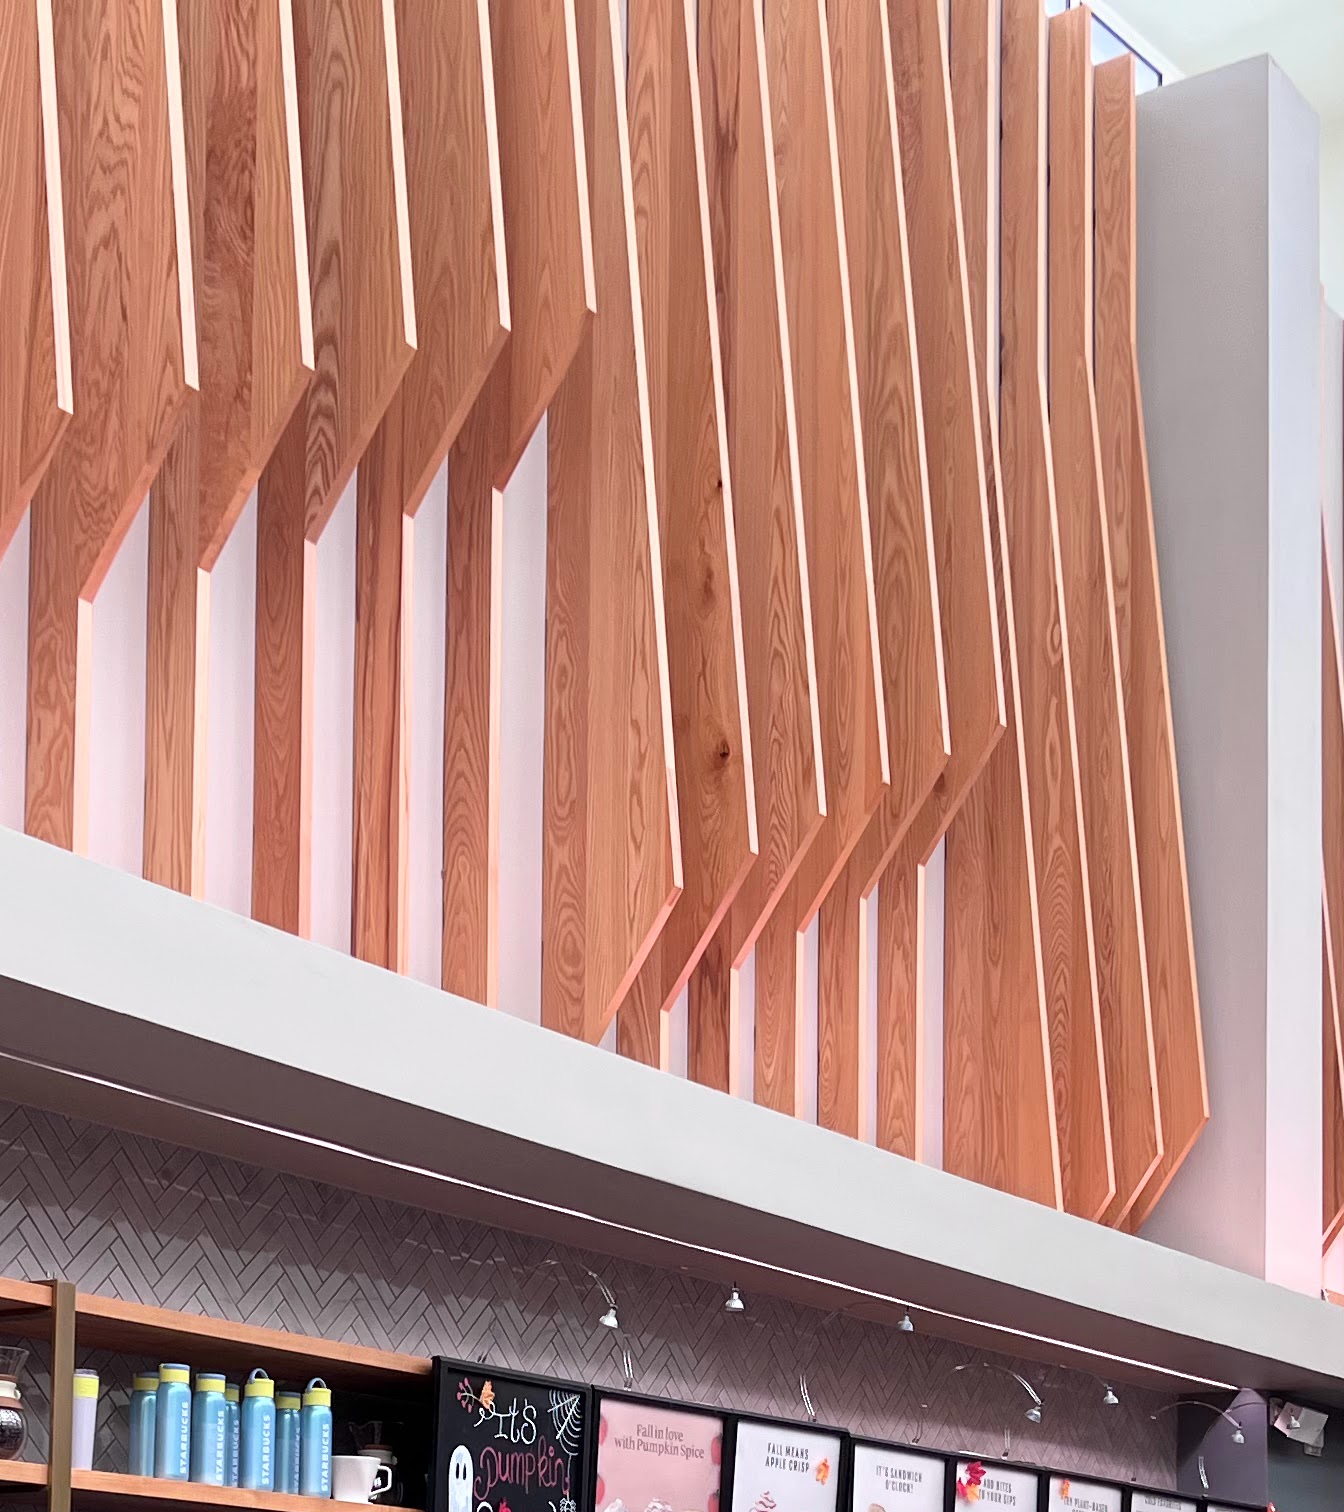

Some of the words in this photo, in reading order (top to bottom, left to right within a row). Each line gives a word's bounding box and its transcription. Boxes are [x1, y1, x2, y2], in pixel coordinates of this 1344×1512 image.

[179, 1401, 190, 1475] STARBUCKS
[636, 1424, 655, 1439] Fall
[655, 1427, 664, 1440] in
[665, 1427, 684, 1442] love
[215, 1410, 225, 1481] STARBUCKS
[261, 1414, 271, 1486] STARBUCKS
[321, 1423, 330, 1492] STARBUCKS
[614, 1436, 636, 1450] with
[637, 1438, 679, 1456] Pumpkin
[680, 1445, 705, 1460] Spice
[767, 1443, 783, 1455] FALL
[785, 1446, 809, 1460] MEANS
[765, 1456, 786, 1470] APPLE
[788, 1459, 810, 1473] CRISP
[890, 1467, 923, 1483] SANDWICH
